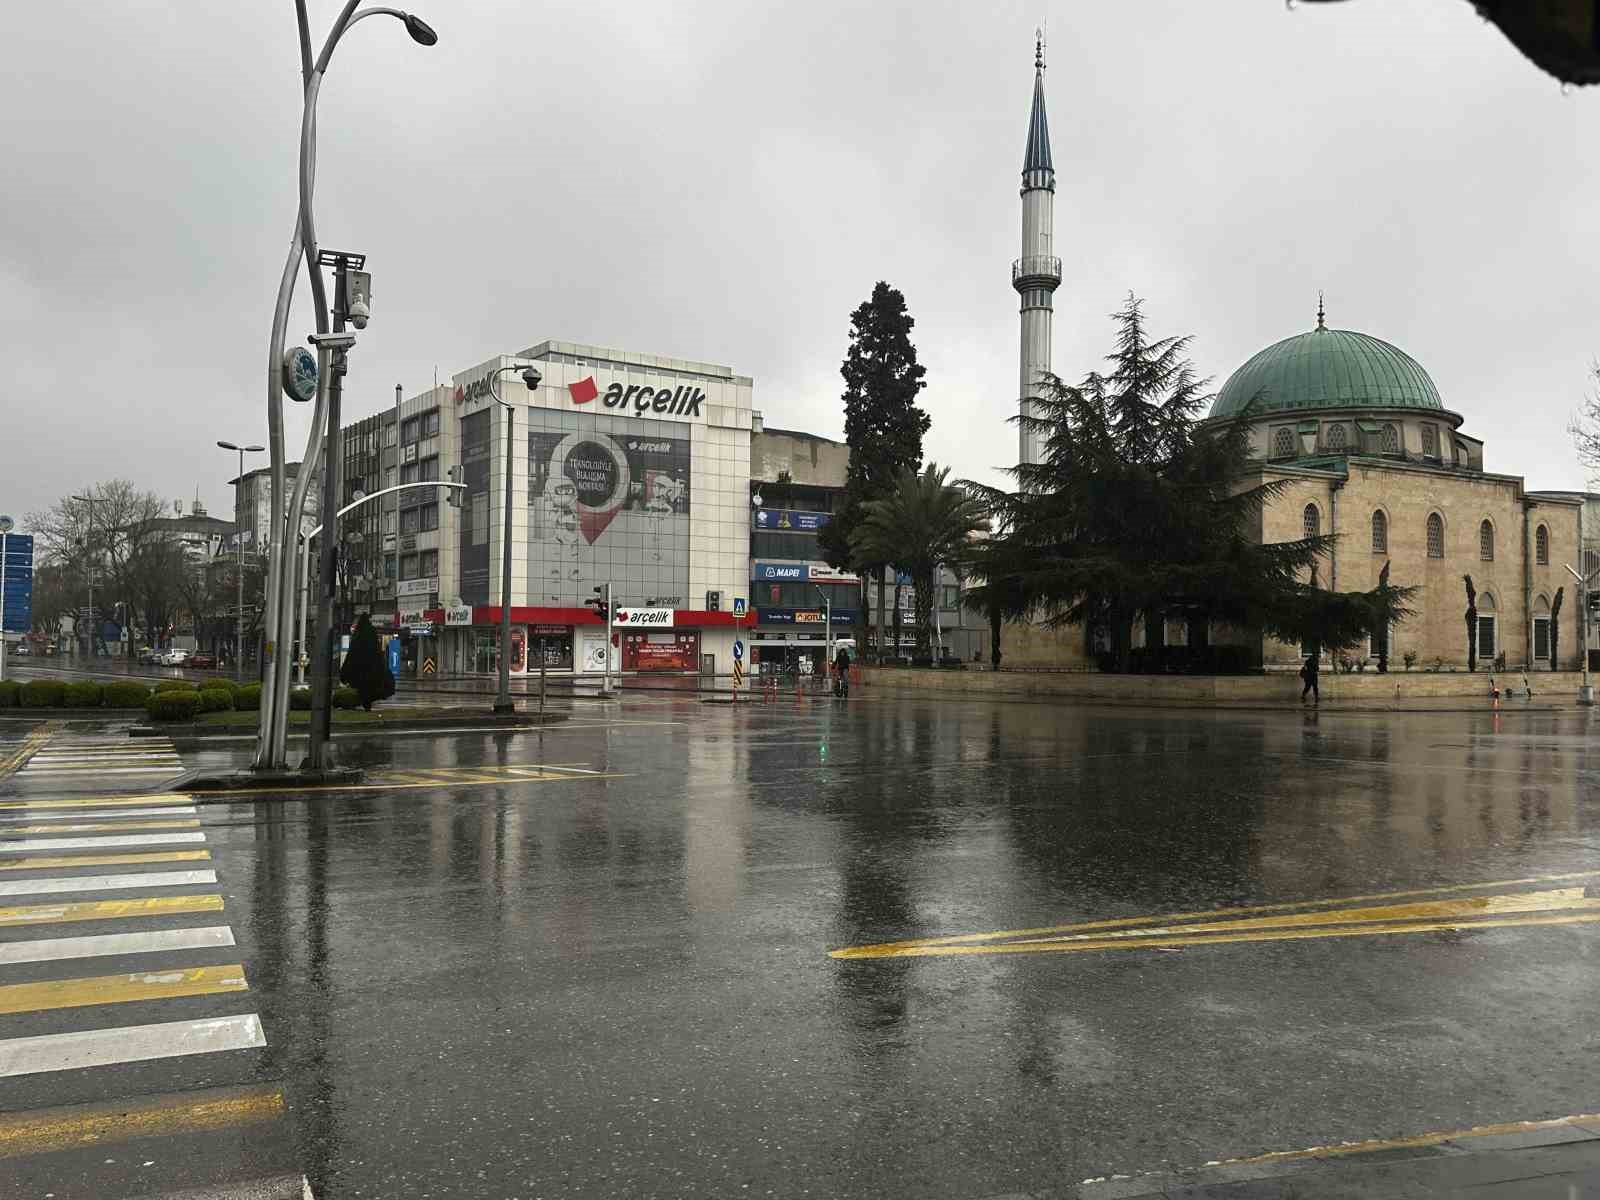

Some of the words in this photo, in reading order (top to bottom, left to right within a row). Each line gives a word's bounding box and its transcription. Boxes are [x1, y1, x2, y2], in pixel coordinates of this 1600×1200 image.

[602, 381, 706, 418] arçelik
[776, 568, 801, 578] MAPEI
[630, 611, 670, 625] arçelik
